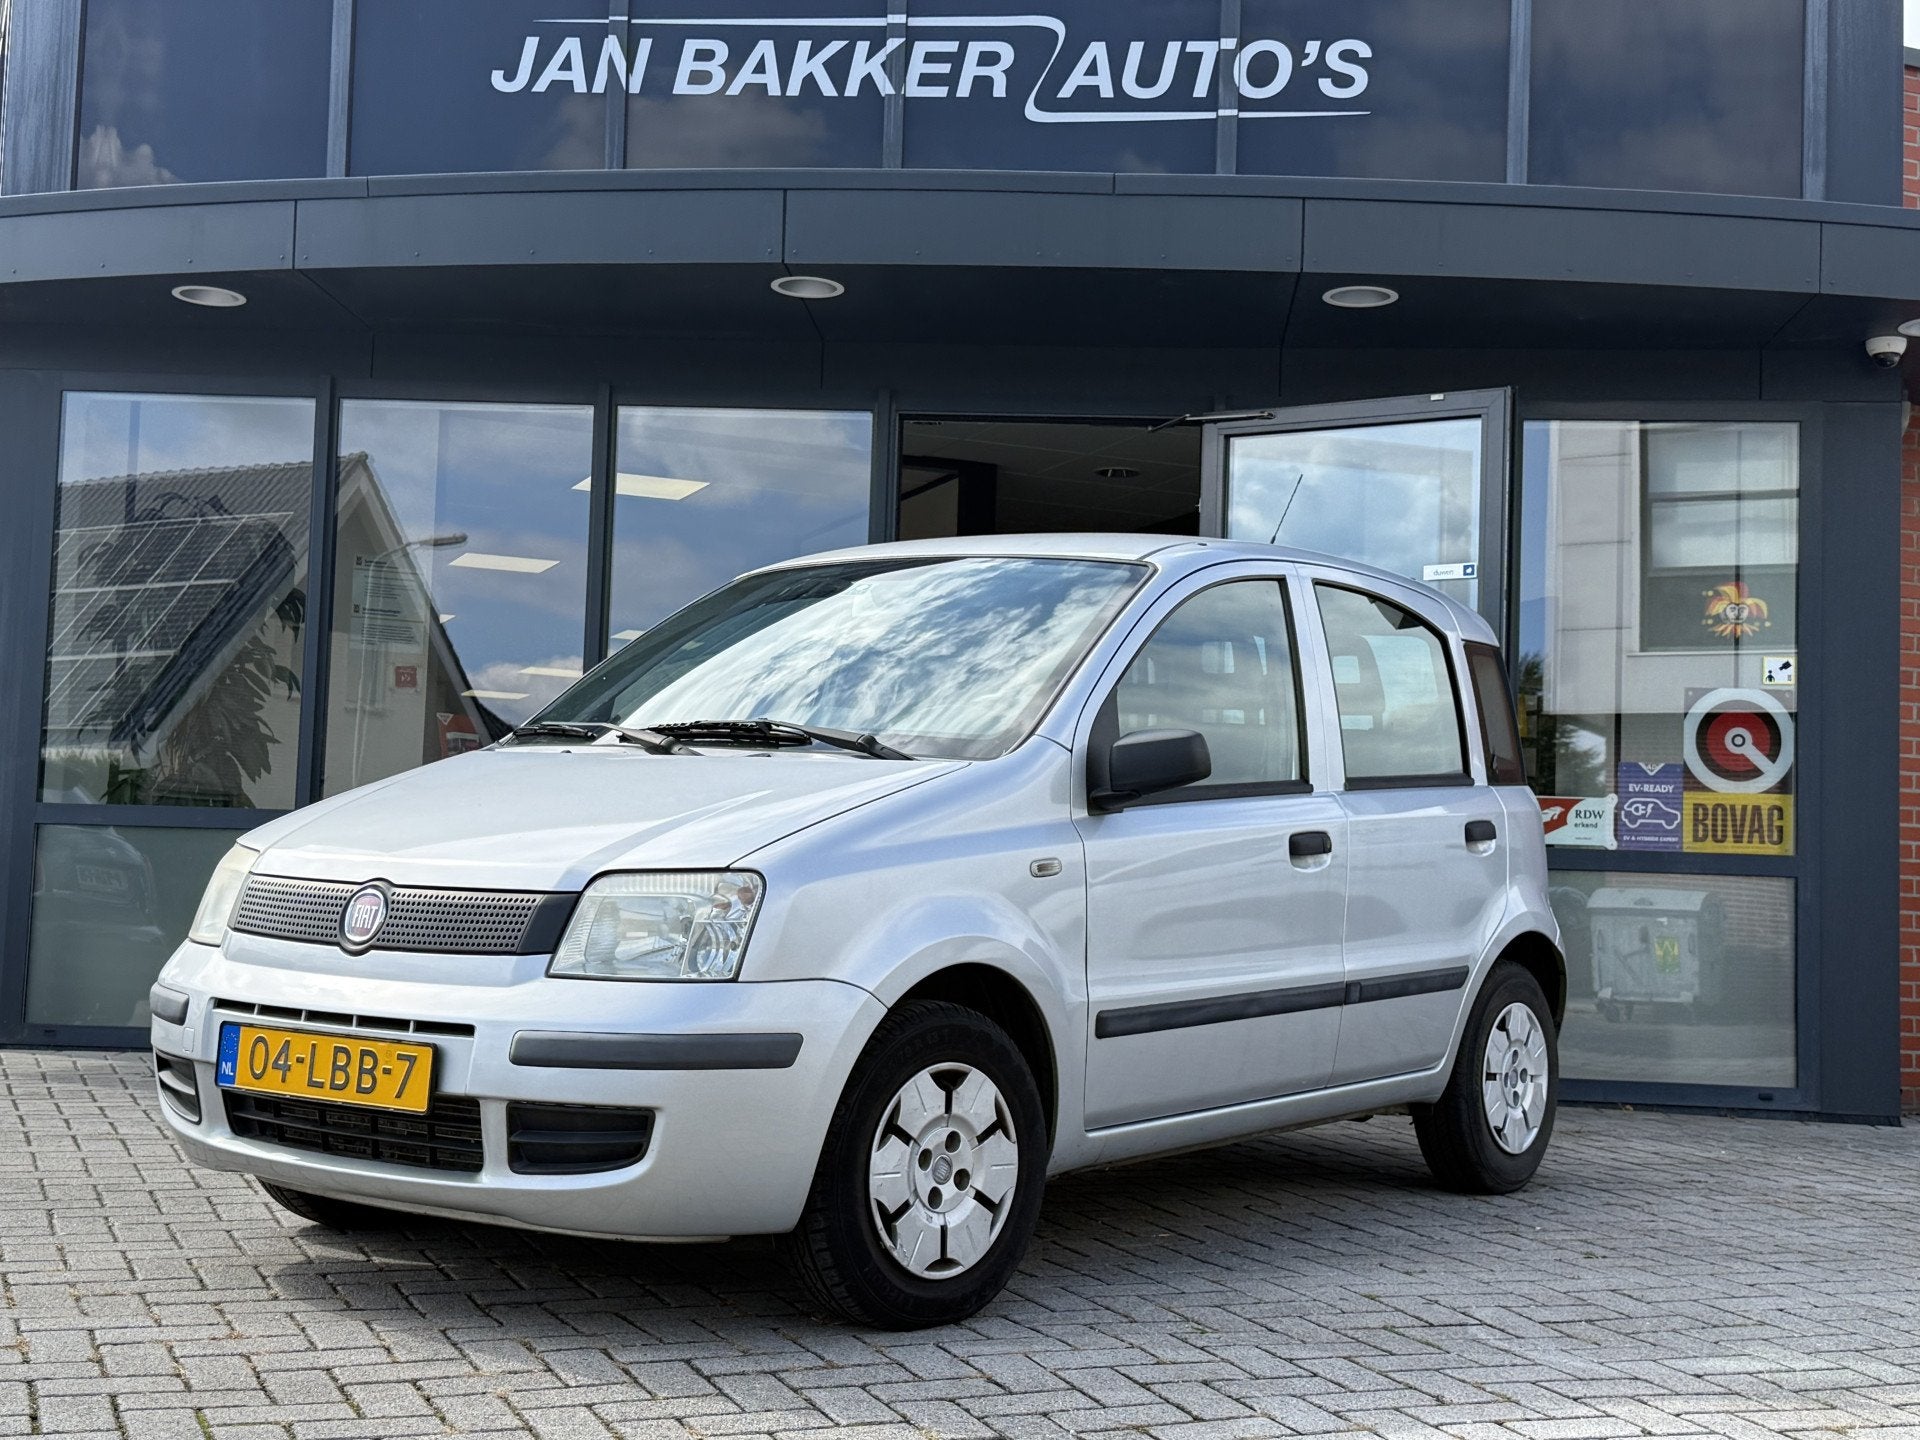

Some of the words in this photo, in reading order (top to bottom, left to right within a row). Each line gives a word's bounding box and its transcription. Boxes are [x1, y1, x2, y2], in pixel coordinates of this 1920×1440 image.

[491, 34, 653, 94] JAN
[672, 38, 1015, 97] BAKKER
[1056, 38, 1373, 99] AUTO'S
[1628, 783, 1675, 793] EV-READY
[1575, 809, 1605, 819] RDW
[1692, 803, 1784, 845] BOVAG
[352, 903, 378, 929] FIAT
[221, 1061, 234, 1076] NL
[250, 1034, 418, 1099] 04-LBB-7
